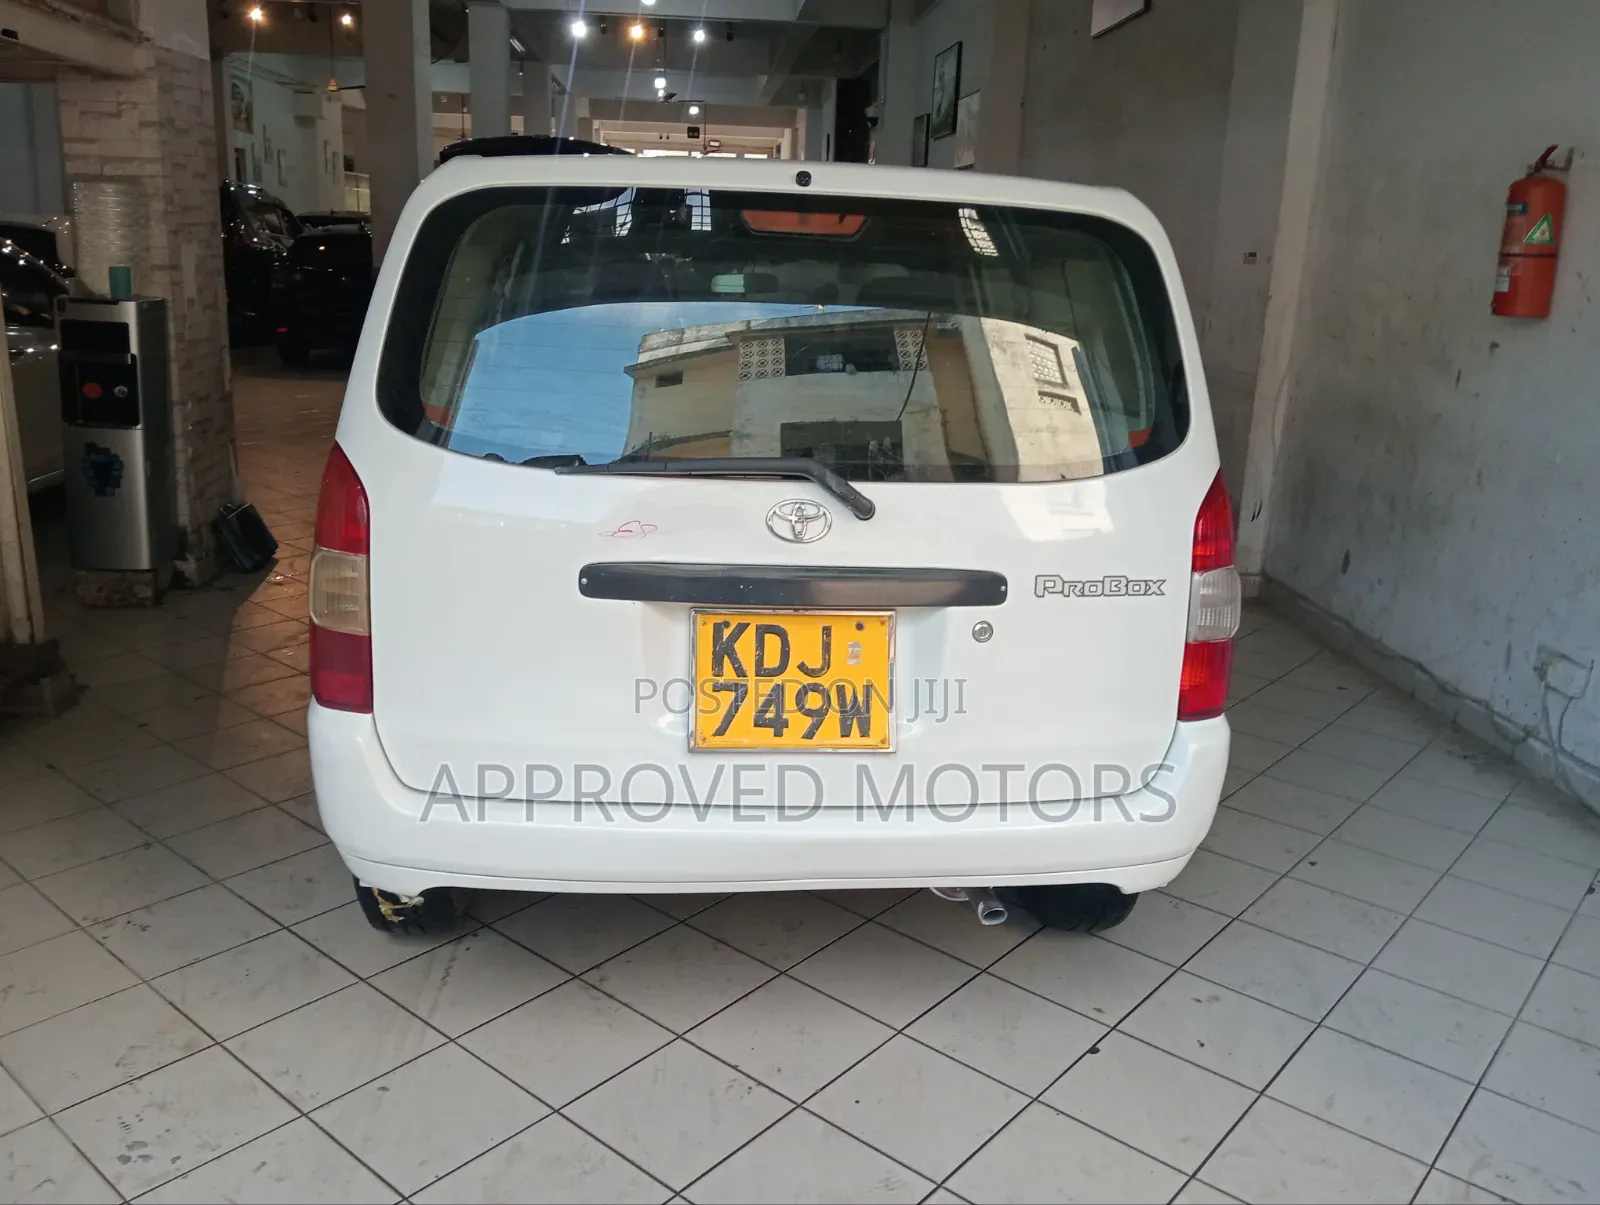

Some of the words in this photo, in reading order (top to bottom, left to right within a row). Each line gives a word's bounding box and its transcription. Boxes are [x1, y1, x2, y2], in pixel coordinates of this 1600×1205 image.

[1034, 574, 1167, 597] ProBox
[712, 622, 832, 678] KDJ
[712, 682, 873, 740] 749W
